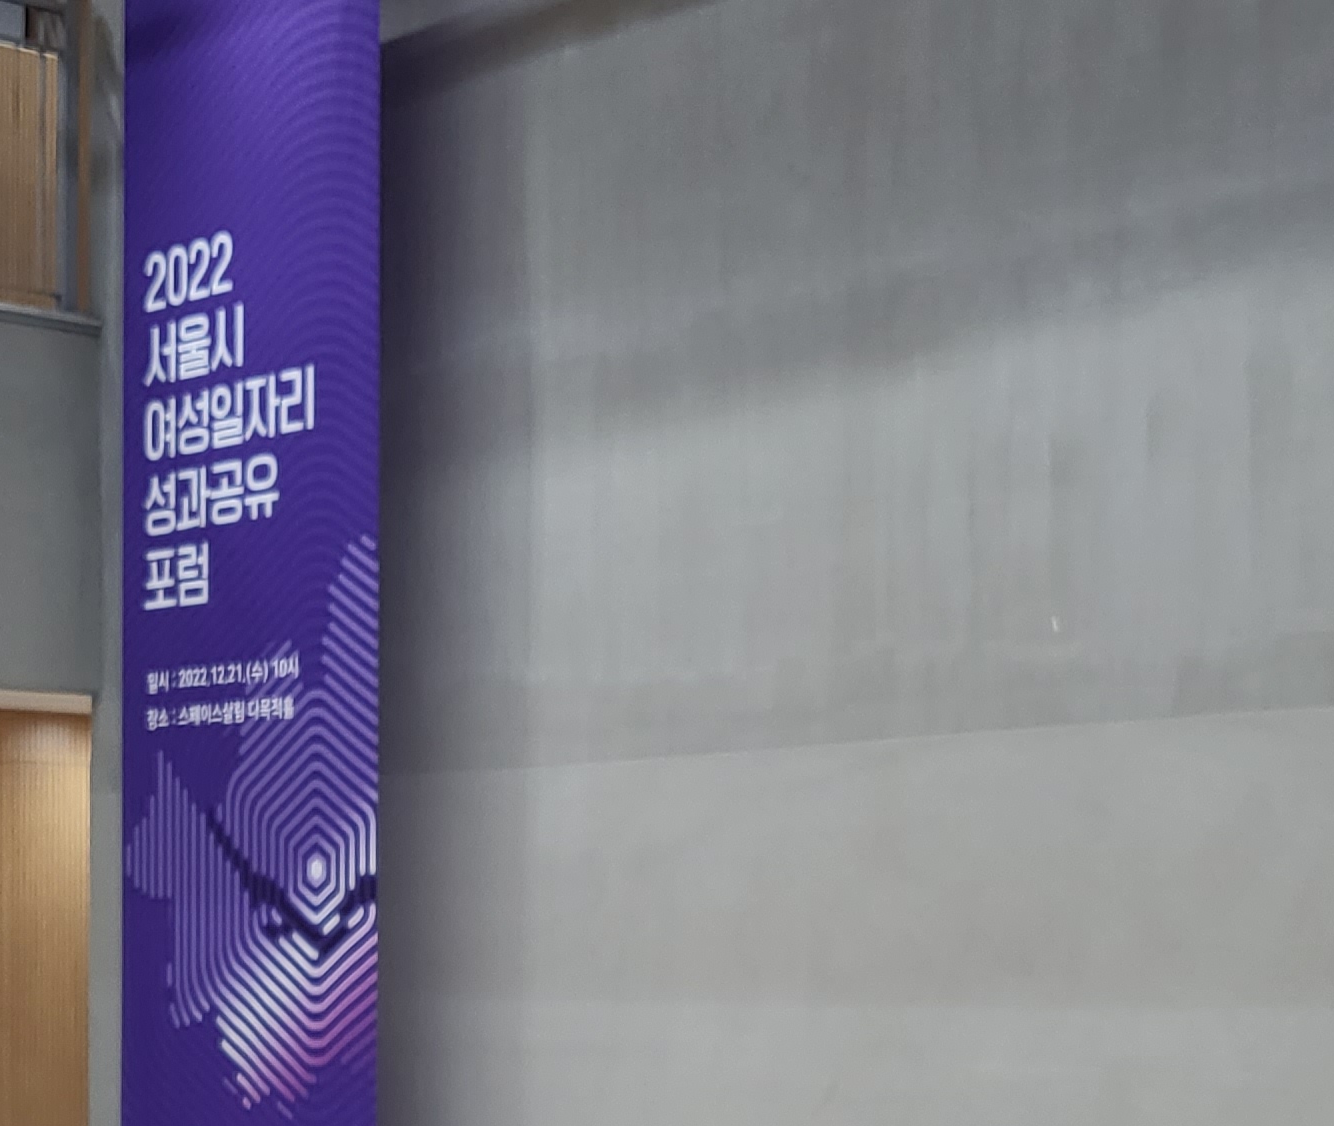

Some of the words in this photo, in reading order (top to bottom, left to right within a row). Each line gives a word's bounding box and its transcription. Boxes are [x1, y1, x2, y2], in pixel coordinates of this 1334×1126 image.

[143, 230, 234, 313] 2022
[143, 302, 245, 386] 서울시
[143, 364, 315, 461] 여성일자리
[143, 453, 280, 536] 성과공유
[143, 543, 209, 610] 포럼
[272, 651, 300, 679] 10시
[177, 699, 245, 726] 스페이스살림
[247, 694, 295, 721] 다목적홀
